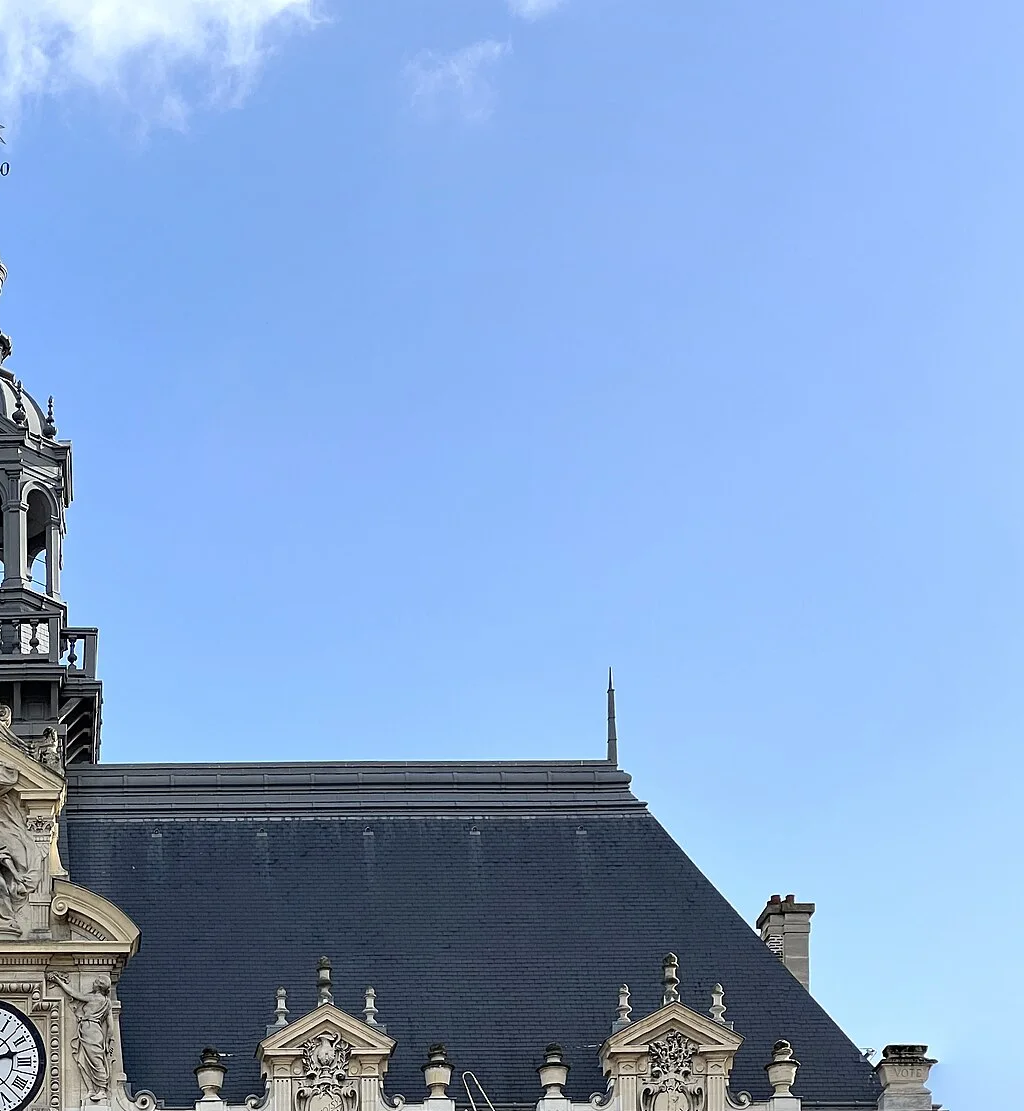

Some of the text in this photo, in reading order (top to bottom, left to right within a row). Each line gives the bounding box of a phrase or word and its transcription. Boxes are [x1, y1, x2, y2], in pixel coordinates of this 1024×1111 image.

[1, 1020, 10, 1033] I
[13, 1036, 26, 1048] II
[17, 1057, 31, 1067] III
[12, 1075, 28, 1090] IIII
[0, 1092, 12, 1106] V
